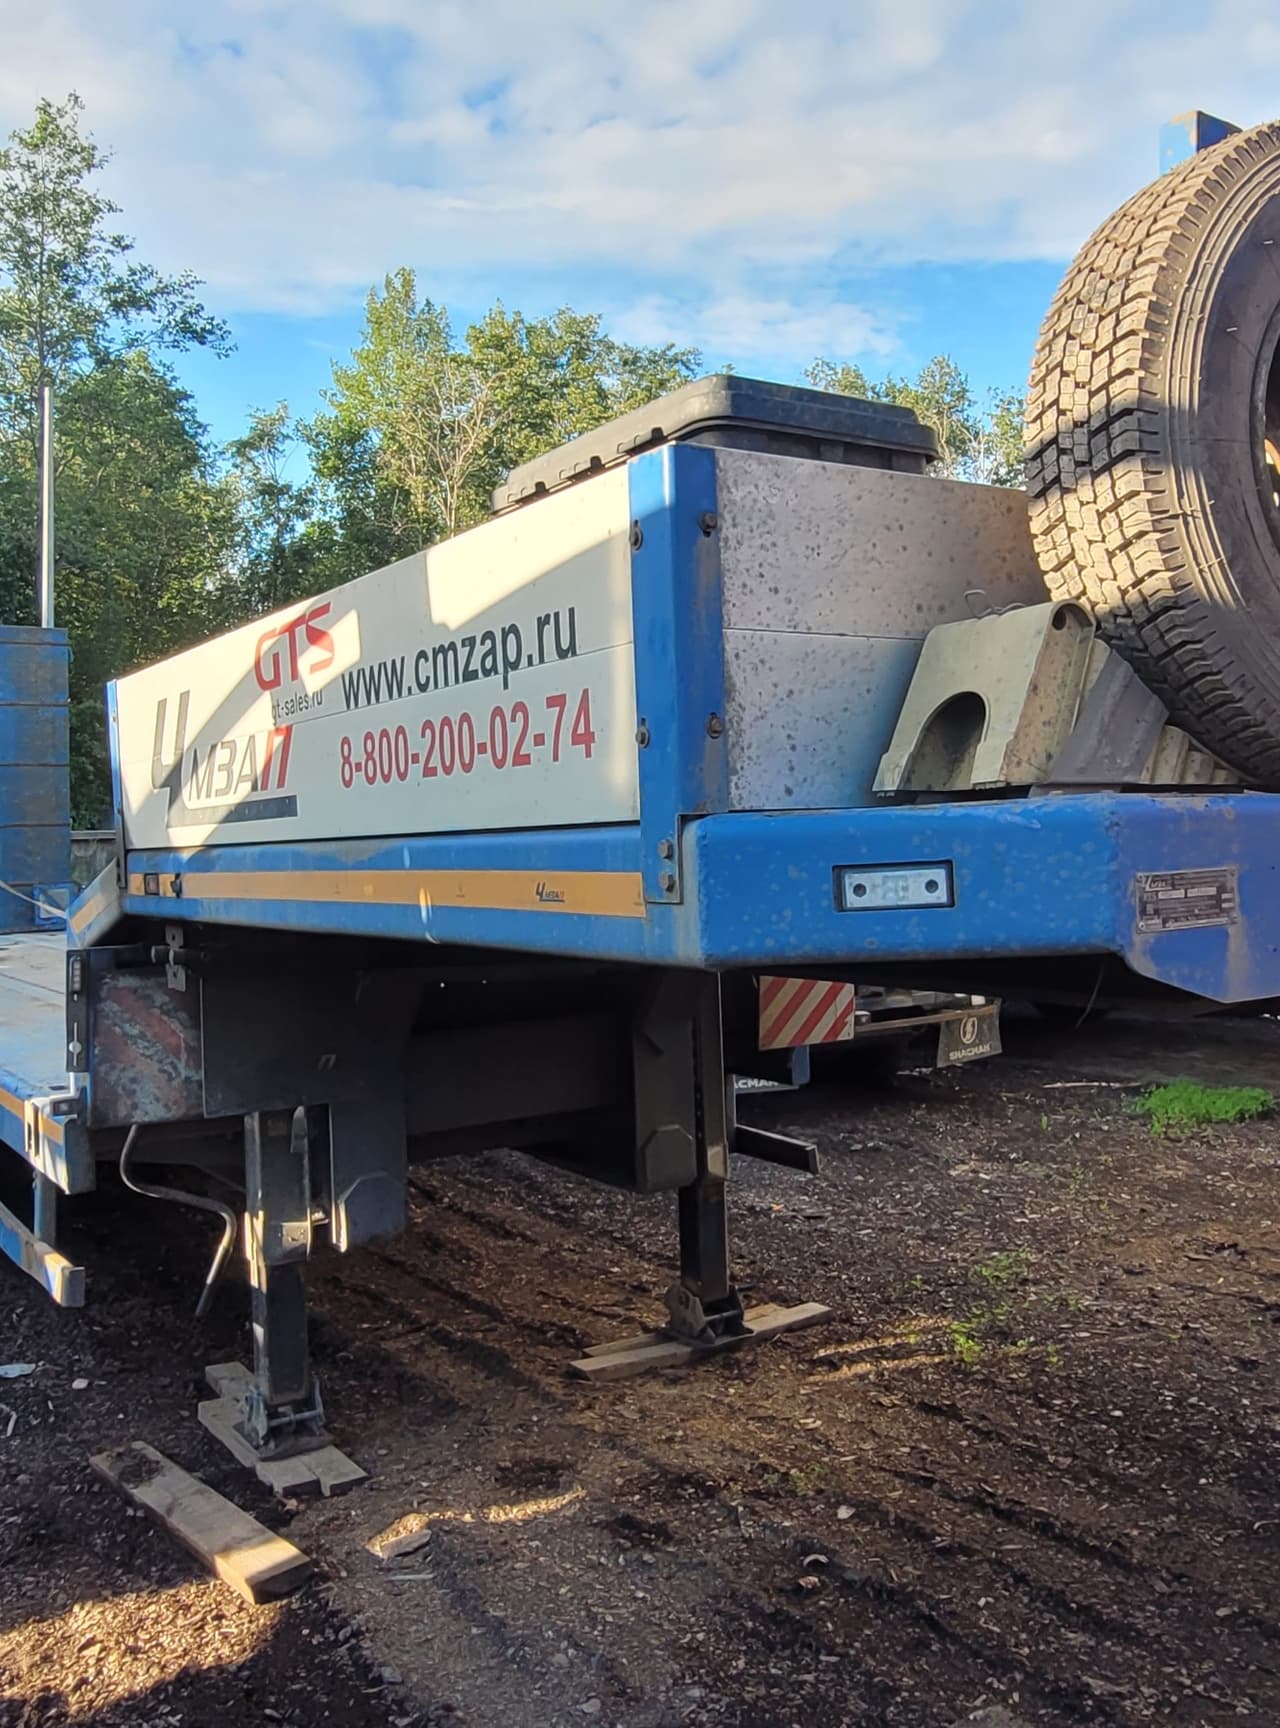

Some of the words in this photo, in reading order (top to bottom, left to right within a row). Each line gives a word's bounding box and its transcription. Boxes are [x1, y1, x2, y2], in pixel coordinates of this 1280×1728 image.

[254, 602, 335, 691] GTS
[341, 606, 579, 710] www.cmzap.ru
[271, 689, 323, 727] gt-sales.ru
[340, 688, 596, 788] 8-800-200-02-74
